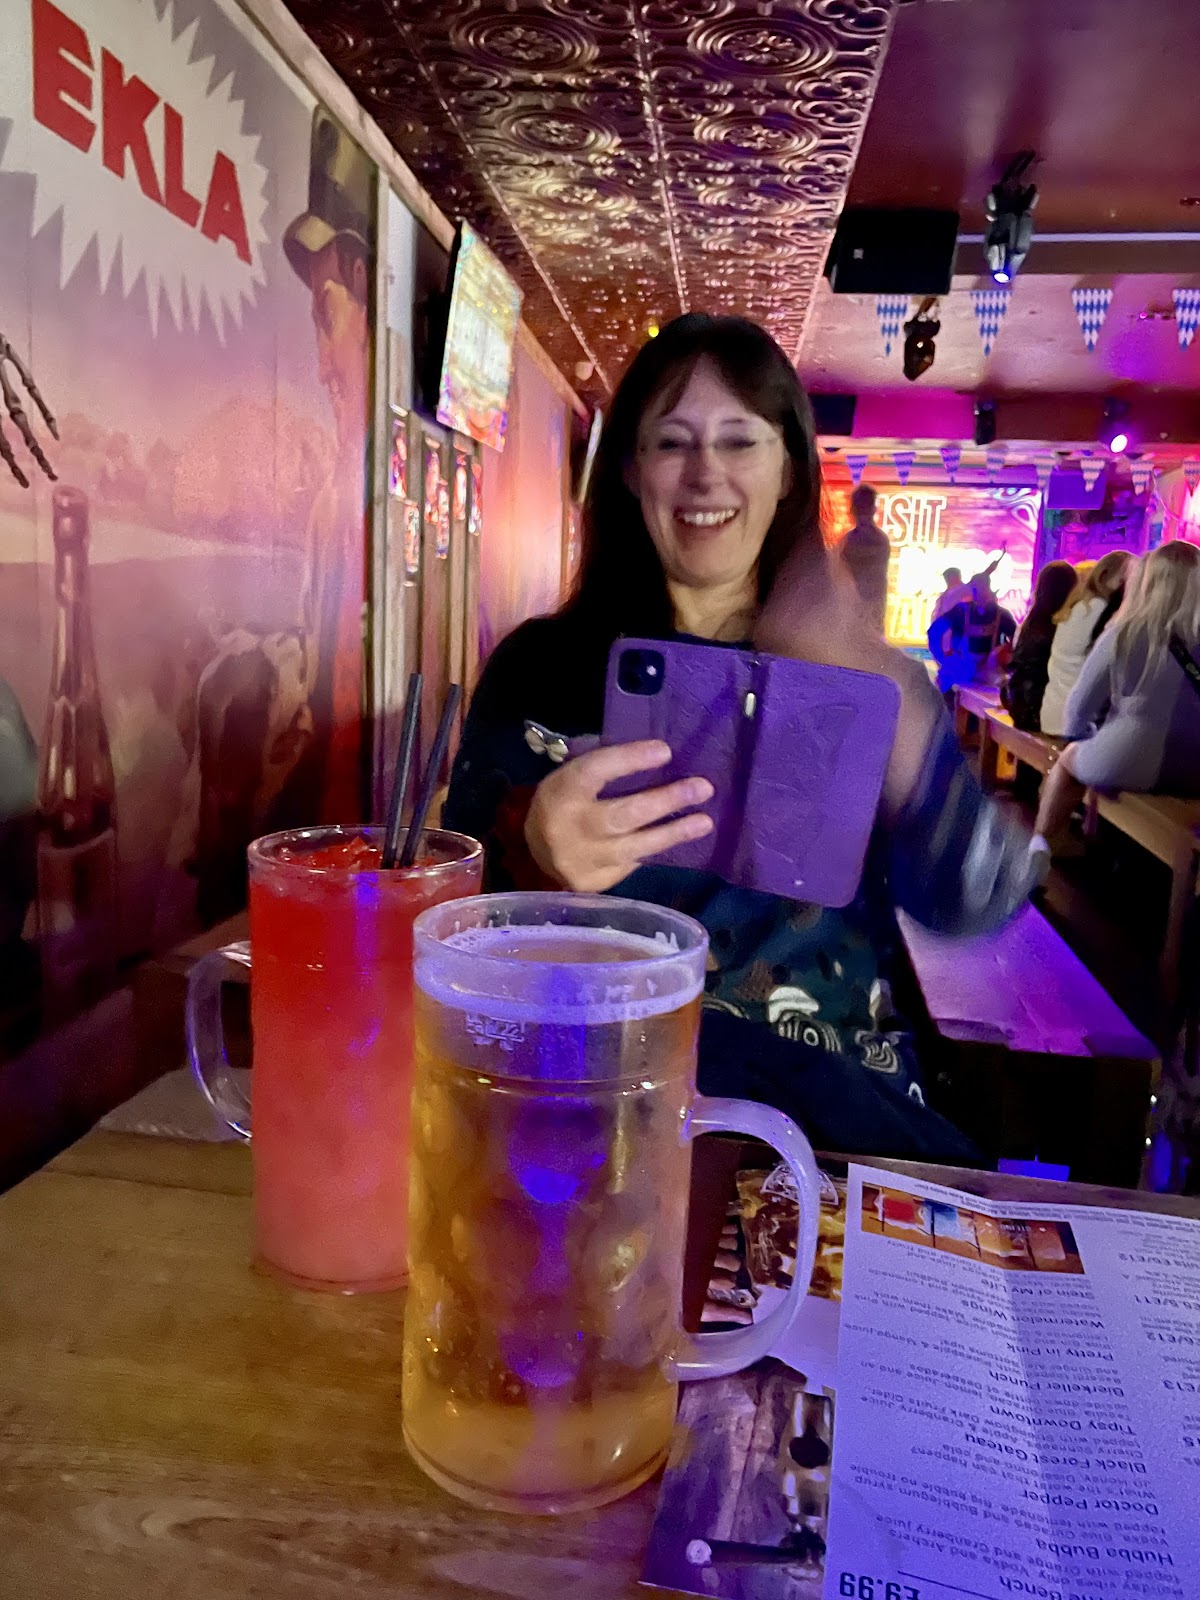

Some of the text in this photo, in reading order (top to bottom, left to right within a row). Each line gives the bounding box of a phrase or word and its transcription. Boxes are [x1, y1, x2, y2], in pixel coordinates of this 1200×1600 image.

[31, 0, 253, 266] EKLA
[876, 493, 948, 547] ISIT
[907, 1251, 927, 1261] and
[917, 1248, 936, 1257] and
[928, 1282, 948, 1292] and
[981, 1278, 1007, 1293] Life
[1011, 1287, 1033, 1295] My
[854, 1294, 878, 1304] Pink
[1056, 1289, 1095, 1300] Stein
[881, 1299, 905, 1310] with
[903, 1297, 931, 1309] them
[910, 1306, 949, 1322] topped
[935, 1305, 965, 1319] Make
[961, 1299, 1105, 1329] Watermelon Wings
[842, 1323, 874, 1335] juice
[877, 1330, 916, 1346] Mango
[921, 1341, 929, 1349] &
[940, 1339, 964, 1350] ups!
[933, 1344, 992, 1368] Pineapple
[969, 1346, 1019, 1368] Bottoms
[1006, 1342, 1114, 1362] Pretty in Pink
[861, 1361, 875, 1369] an
[879, 1364, 901, 1375] and
[996, 1363, 1021, 1376] with
[1096, 1367, 1118, 1376] and
[907, 1371, 939, 1385] Juice
[910, 1364, 982, 1390] Desperados
[989, 1370, 1124, 1397] Bierkeller Punch
[944, 1382, 982, 1398] lemon
[986, 1385, 999, 1394] of
[861, 1396, 894, 1409] Juice
[908, 1399, 946, 1414] Fruits
[900, 1405, 964, 1429] Cranberry
[950, 1409, 980, 1424] Dark
[1047, 1408, 1075, 1417] Blue
[968, 1423, 976, 1432] &
[990, 1405, 1137, 1436] Tipsy Downtown
[982, 1427, 1017, 1444] Apple
[984, 1419, 1053, 1441] Strongbow
[1059, 1435, 1087, 1444] with
[1093, 1437, 1140, 1449] topped
[910, 1447, 967, 1468] happen?
[942, 1444, 971, 1457] cola
[964, 1433, 1147, 1475] Black Forest Gateau
[1097, 1448, 1143, 1459] Cherry
[974, 1453, 1000, 1465] and
[850, 1464, 896, 1482] trouble
[972, 1462, 997, 1475] can
[854, 1476, 893, 1491] syrup
[901, 1476, 916, 1486] no
[1002, 1471, 1029, 1486] that
[1033, 1479, 1072, 1491] worst
[921, 1483, 966, 1501] bubble
[1078, 1485, 1099, 1494] the
[899, 1488, 978, 1516] Bubblegum
[971, 1495, 992, 1508] Big
[1018, 1489, 1158, 1516] Doctor Pepper
[983, 1510, 1009, 1524] and
[1077, 1520, 1108, 1529] with
[1114, 1522, 1166, 1535] topped
[889, 1529, 944, 1553] Archers
[876, 1514, 1179, 1584] topped with Orange and Cranberry juice
[950, 1547, 977, 1560] and
[1035, 1538, 1174, 1566] Hubba Bubba
[983, 1556, 1029, 1577] Vodka
[839, 1572, 920, 1600] £9.99
